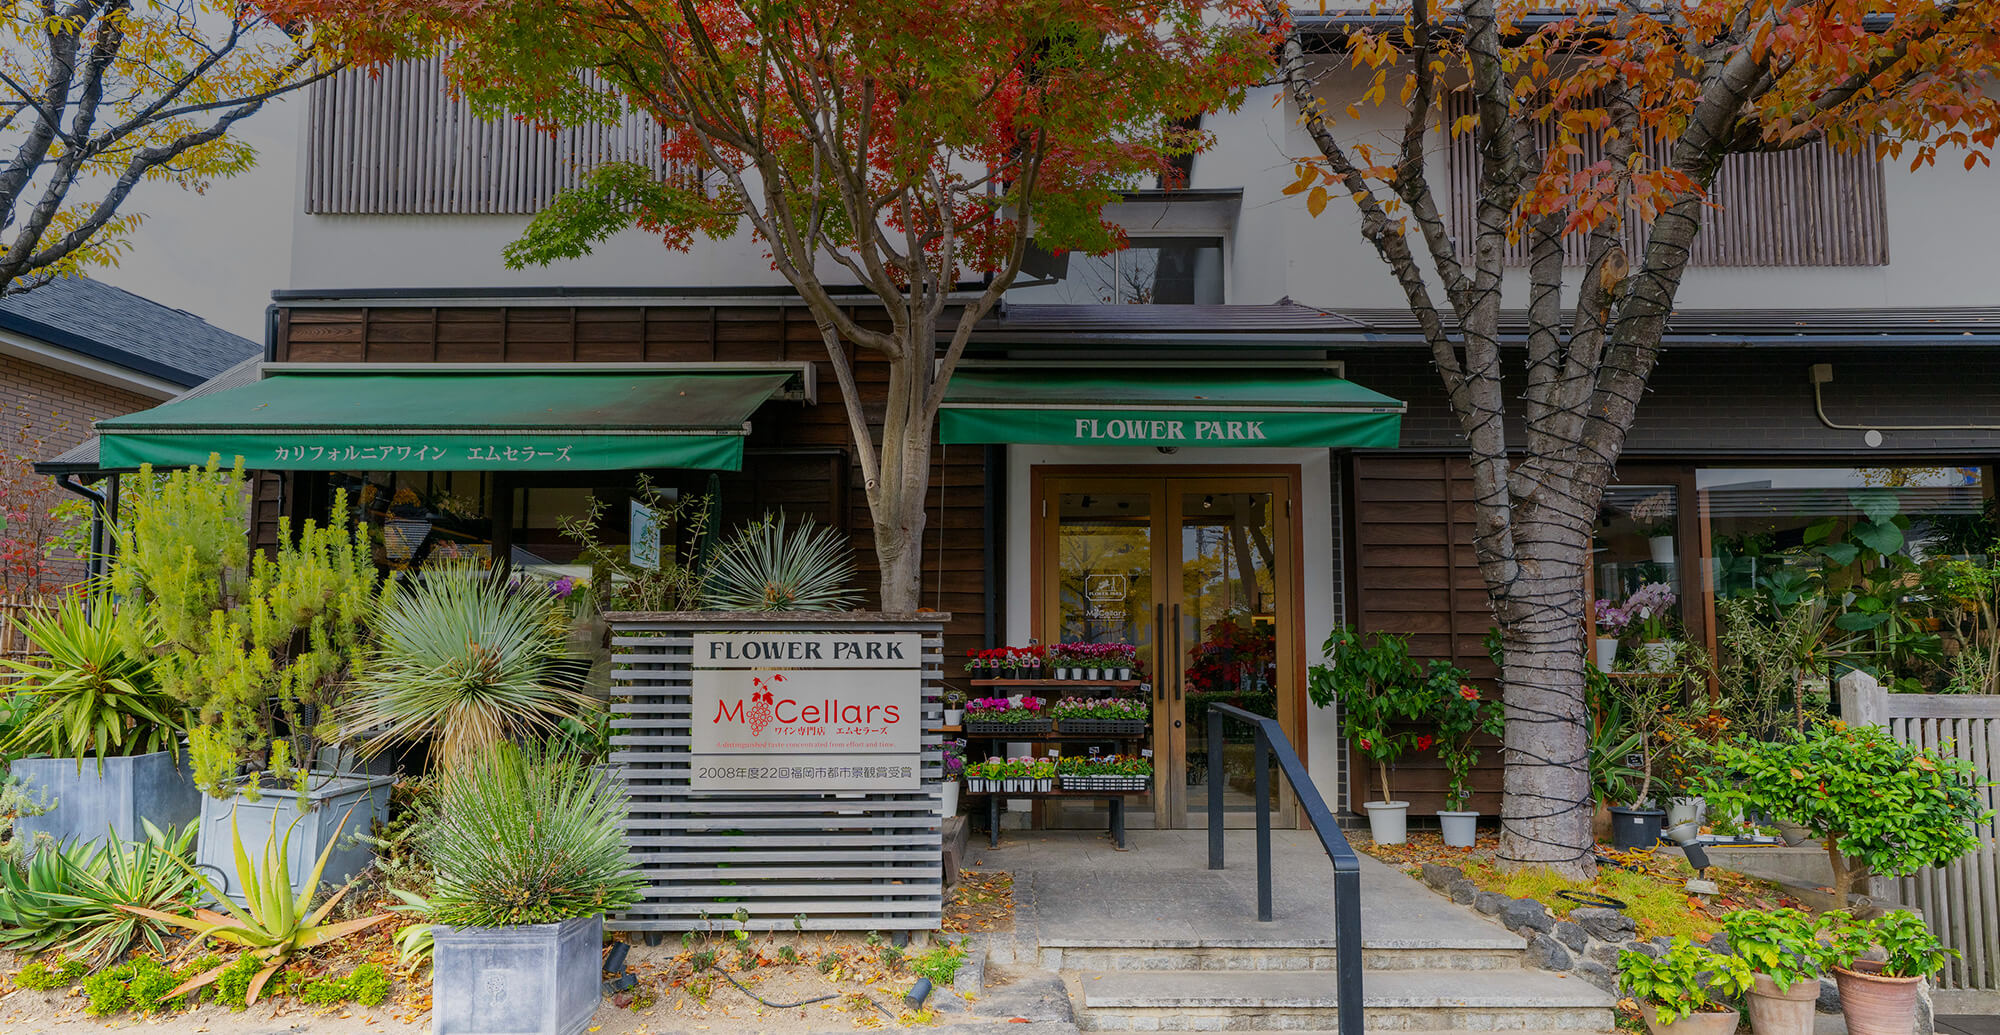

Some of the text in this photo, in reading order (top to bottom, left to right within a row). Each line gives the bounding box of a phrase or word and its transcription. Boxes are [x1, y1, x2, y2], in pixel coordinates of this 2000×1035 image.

[1075, 420, 1266, 439] FLOWER PARK
[274, 445, 573, 462] カリフォルニアワイン エムセラーズ
[709, 641, 905, 660] FLOWER PARK
[774, 726, 888, 736] ワイン専門店 エムセラーズ
[699, 766, 912, 780] 2008年度22回福岡市都市景観賞受賞
